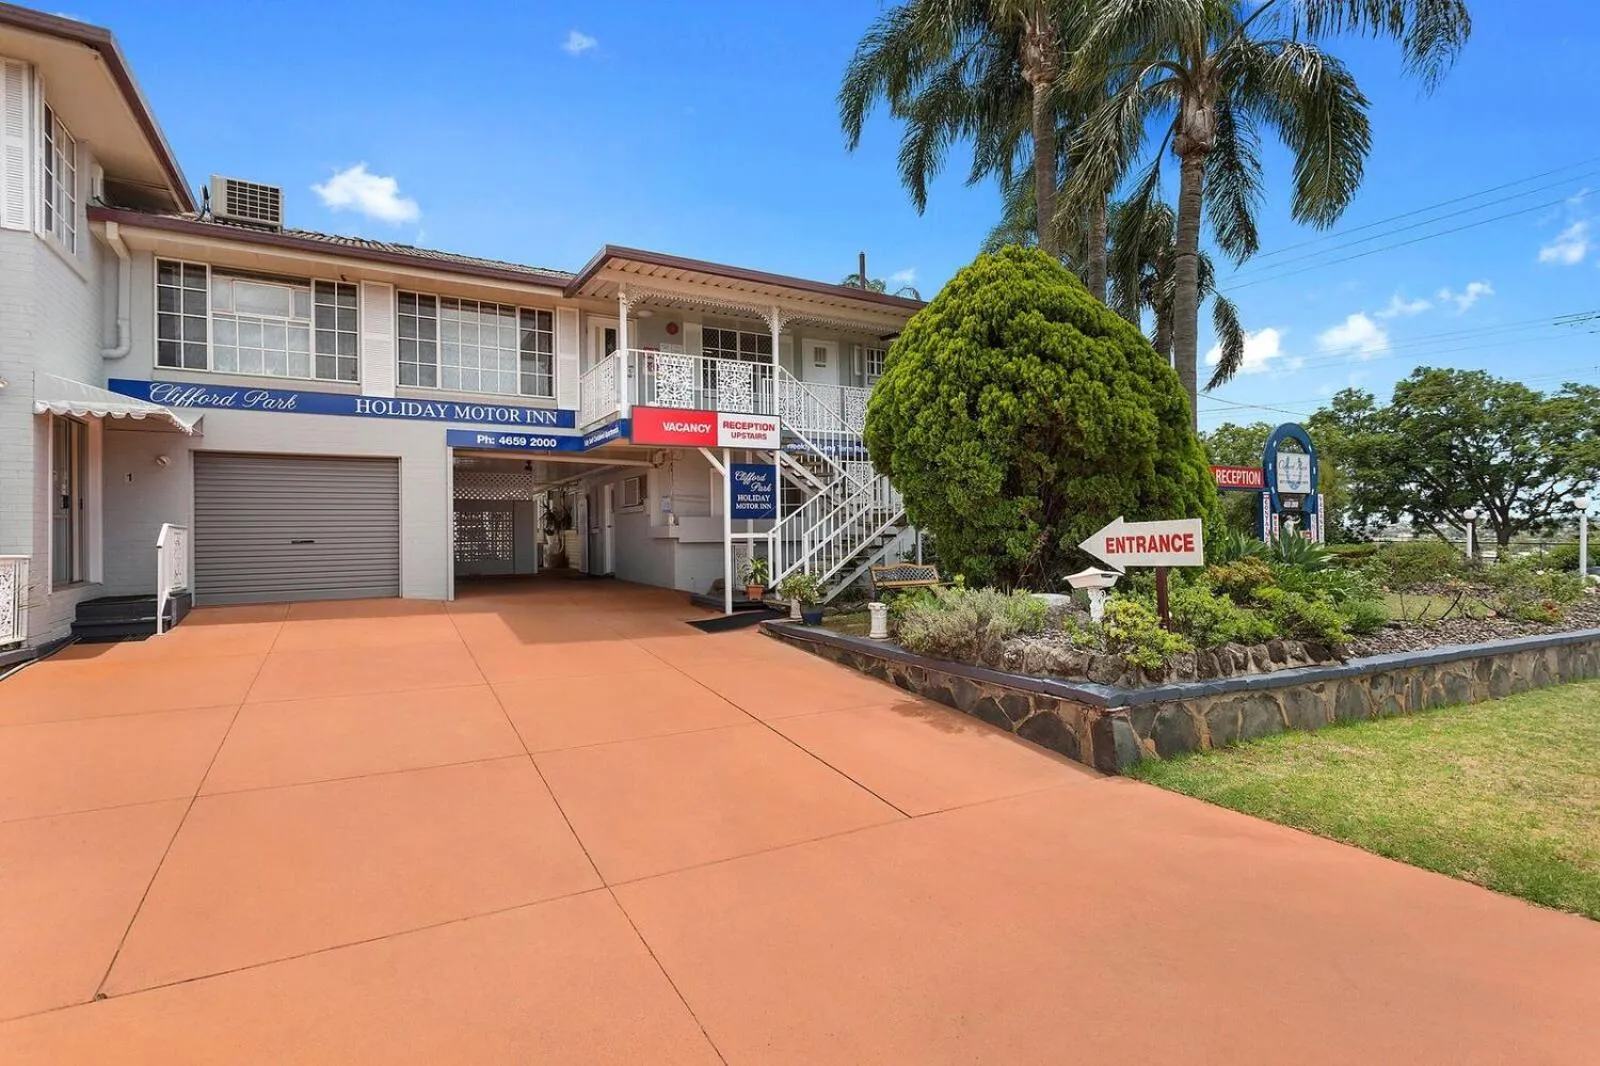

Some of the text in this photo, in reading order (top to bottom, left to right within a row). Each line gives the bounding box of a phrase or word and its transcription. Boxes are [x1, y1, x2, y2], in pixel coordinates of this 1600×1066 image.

[150, 383, 297, 410] Clifford Park
[355, 398, 558, 425] HOLIDAY MOTOR INN
[662, 422, 711, 433] VACANCY
[722, 421, 776, 431] RECEPTION
[477, 434, 557, 448] Ph: 4659 2000
[731, 432, 768, 440] UPSTAIRS
[735, 471, 772, 492] Clifford Park
[1215, 469, 1261, 485] RECEPTION
[737, 494, 770, 502] HOLIDAY
[1105, 533, 1195, 554] ENTRANCE
